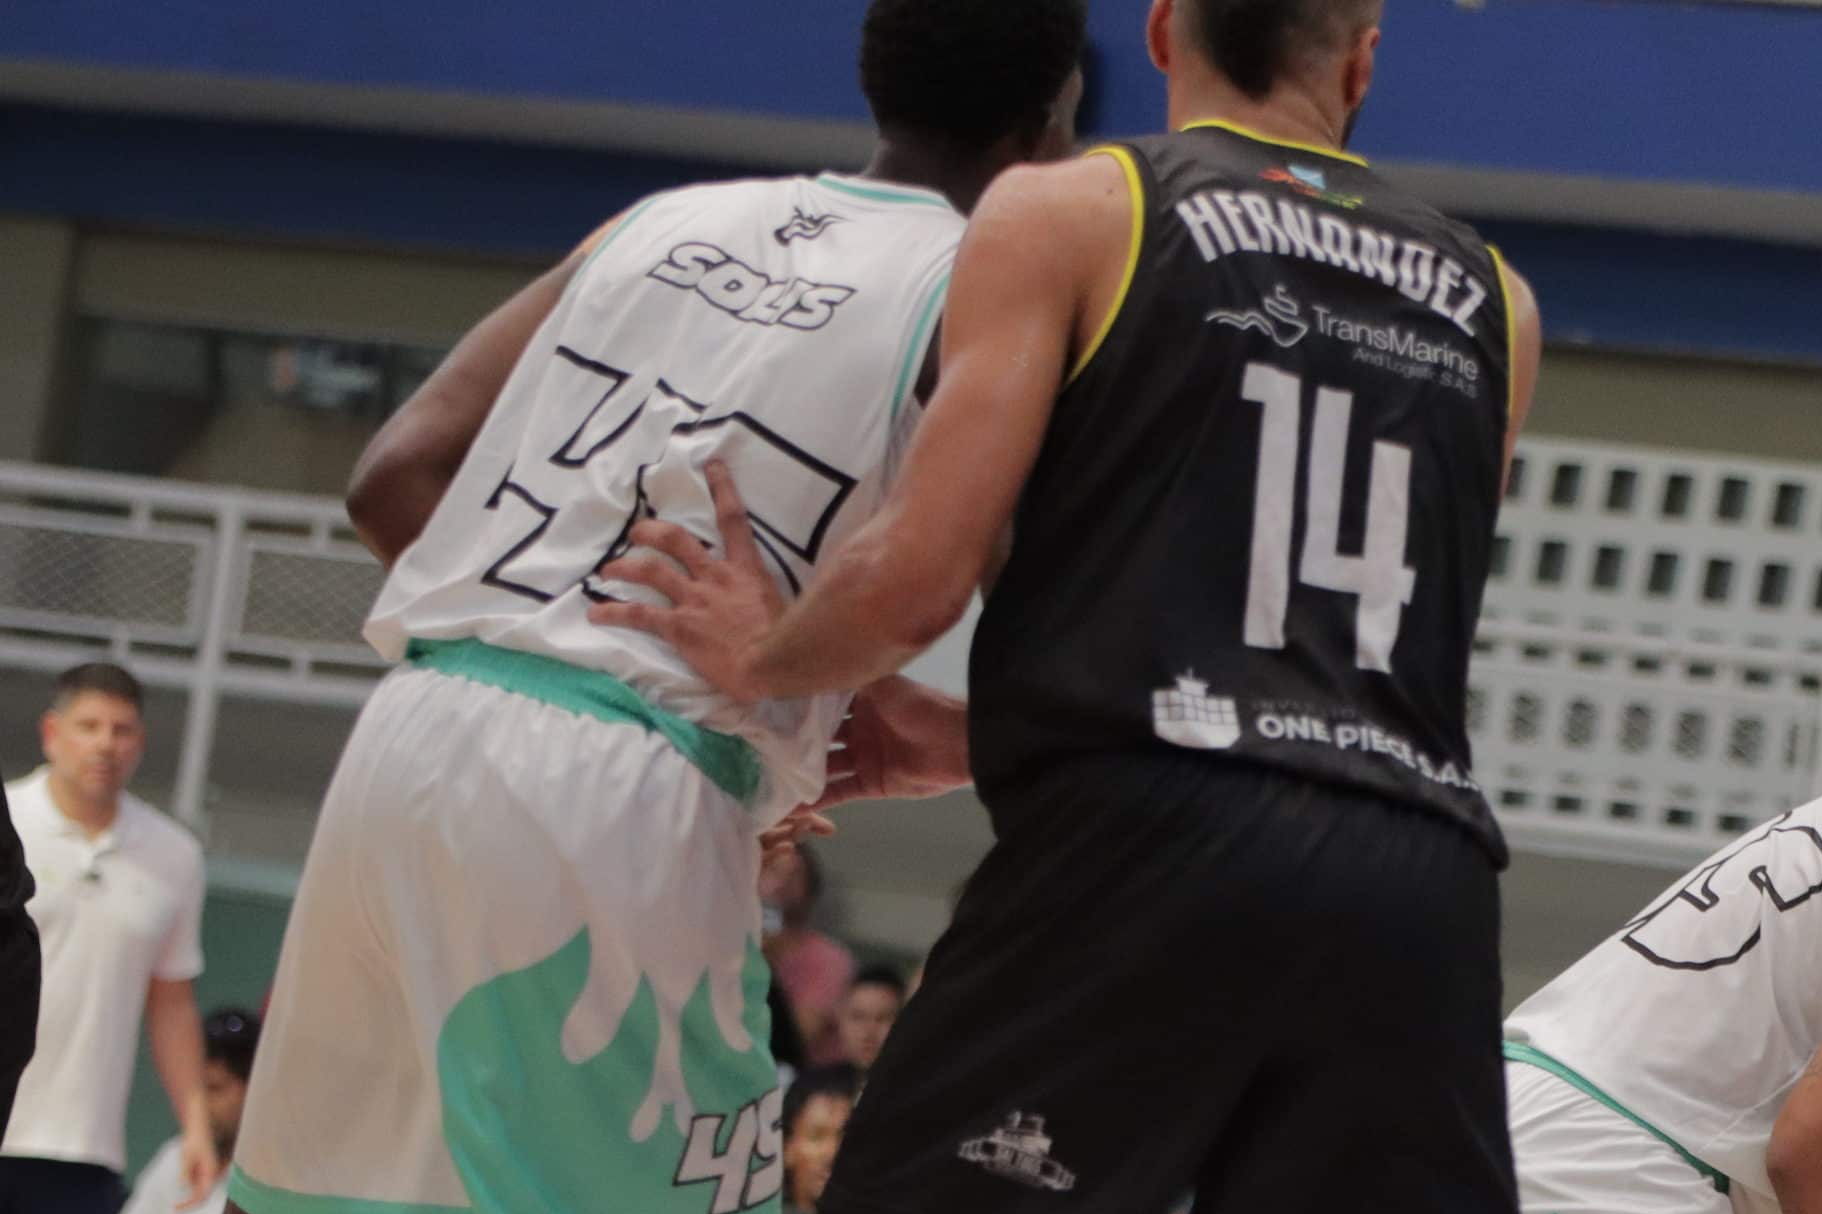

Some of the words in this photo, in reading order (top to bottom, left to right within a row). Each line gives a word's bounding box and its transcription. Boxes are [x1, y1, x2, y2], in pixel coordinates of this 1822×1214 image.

[646, 241, 857, 331] SOLIS
[1176, 190, 1487, 336] HERNANDEZ
[1312, 306, 1479, 381] TransMarine
[1241, 362, 1417, 674] 14
[1256, 713, 1332, 744] ONE
